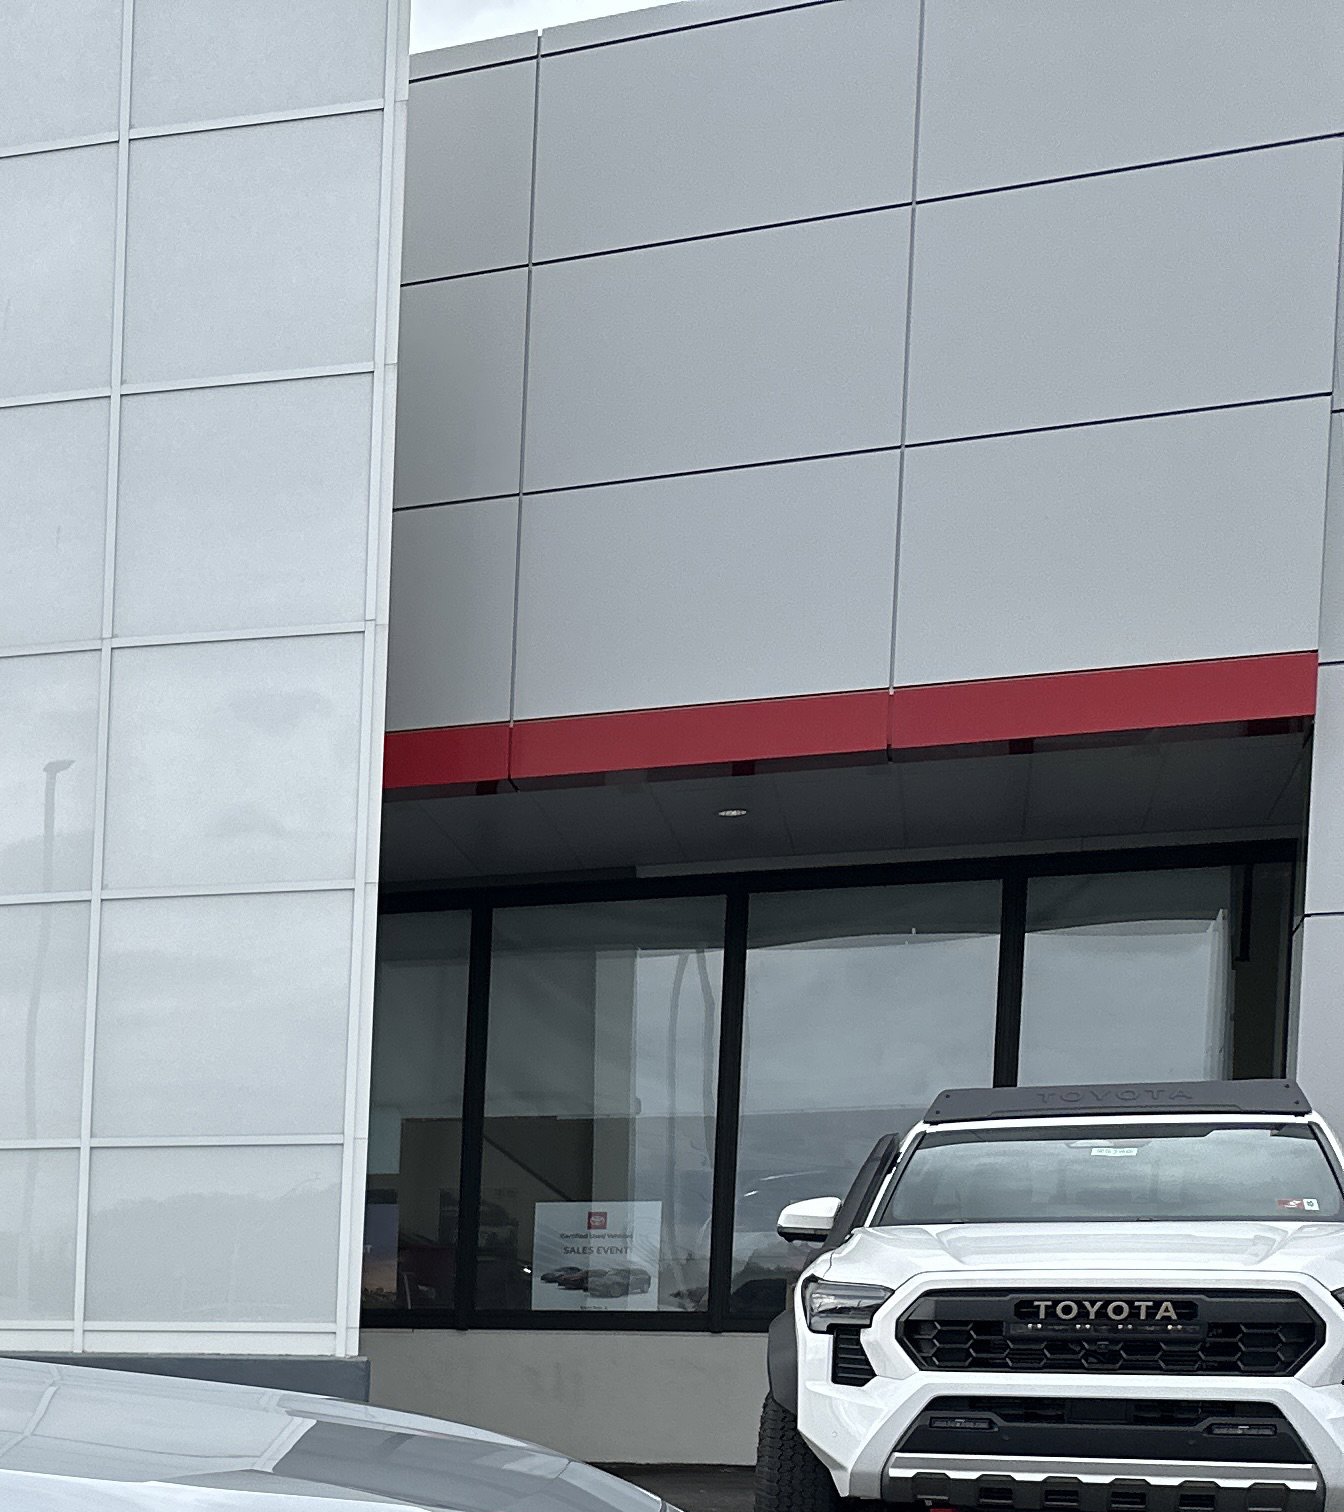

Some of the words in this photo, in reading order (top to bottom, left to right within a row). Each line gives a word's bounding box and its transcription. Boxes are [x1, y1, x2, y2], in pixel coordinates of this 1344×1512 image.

[1036, 1087, 1193, 1104] TOYOTA
[563, 1246, 594, 1255] SALES
[596, 1246, 629, 1255] EVENT
[1033, 1300, 1178, 1320] TOYOTA
